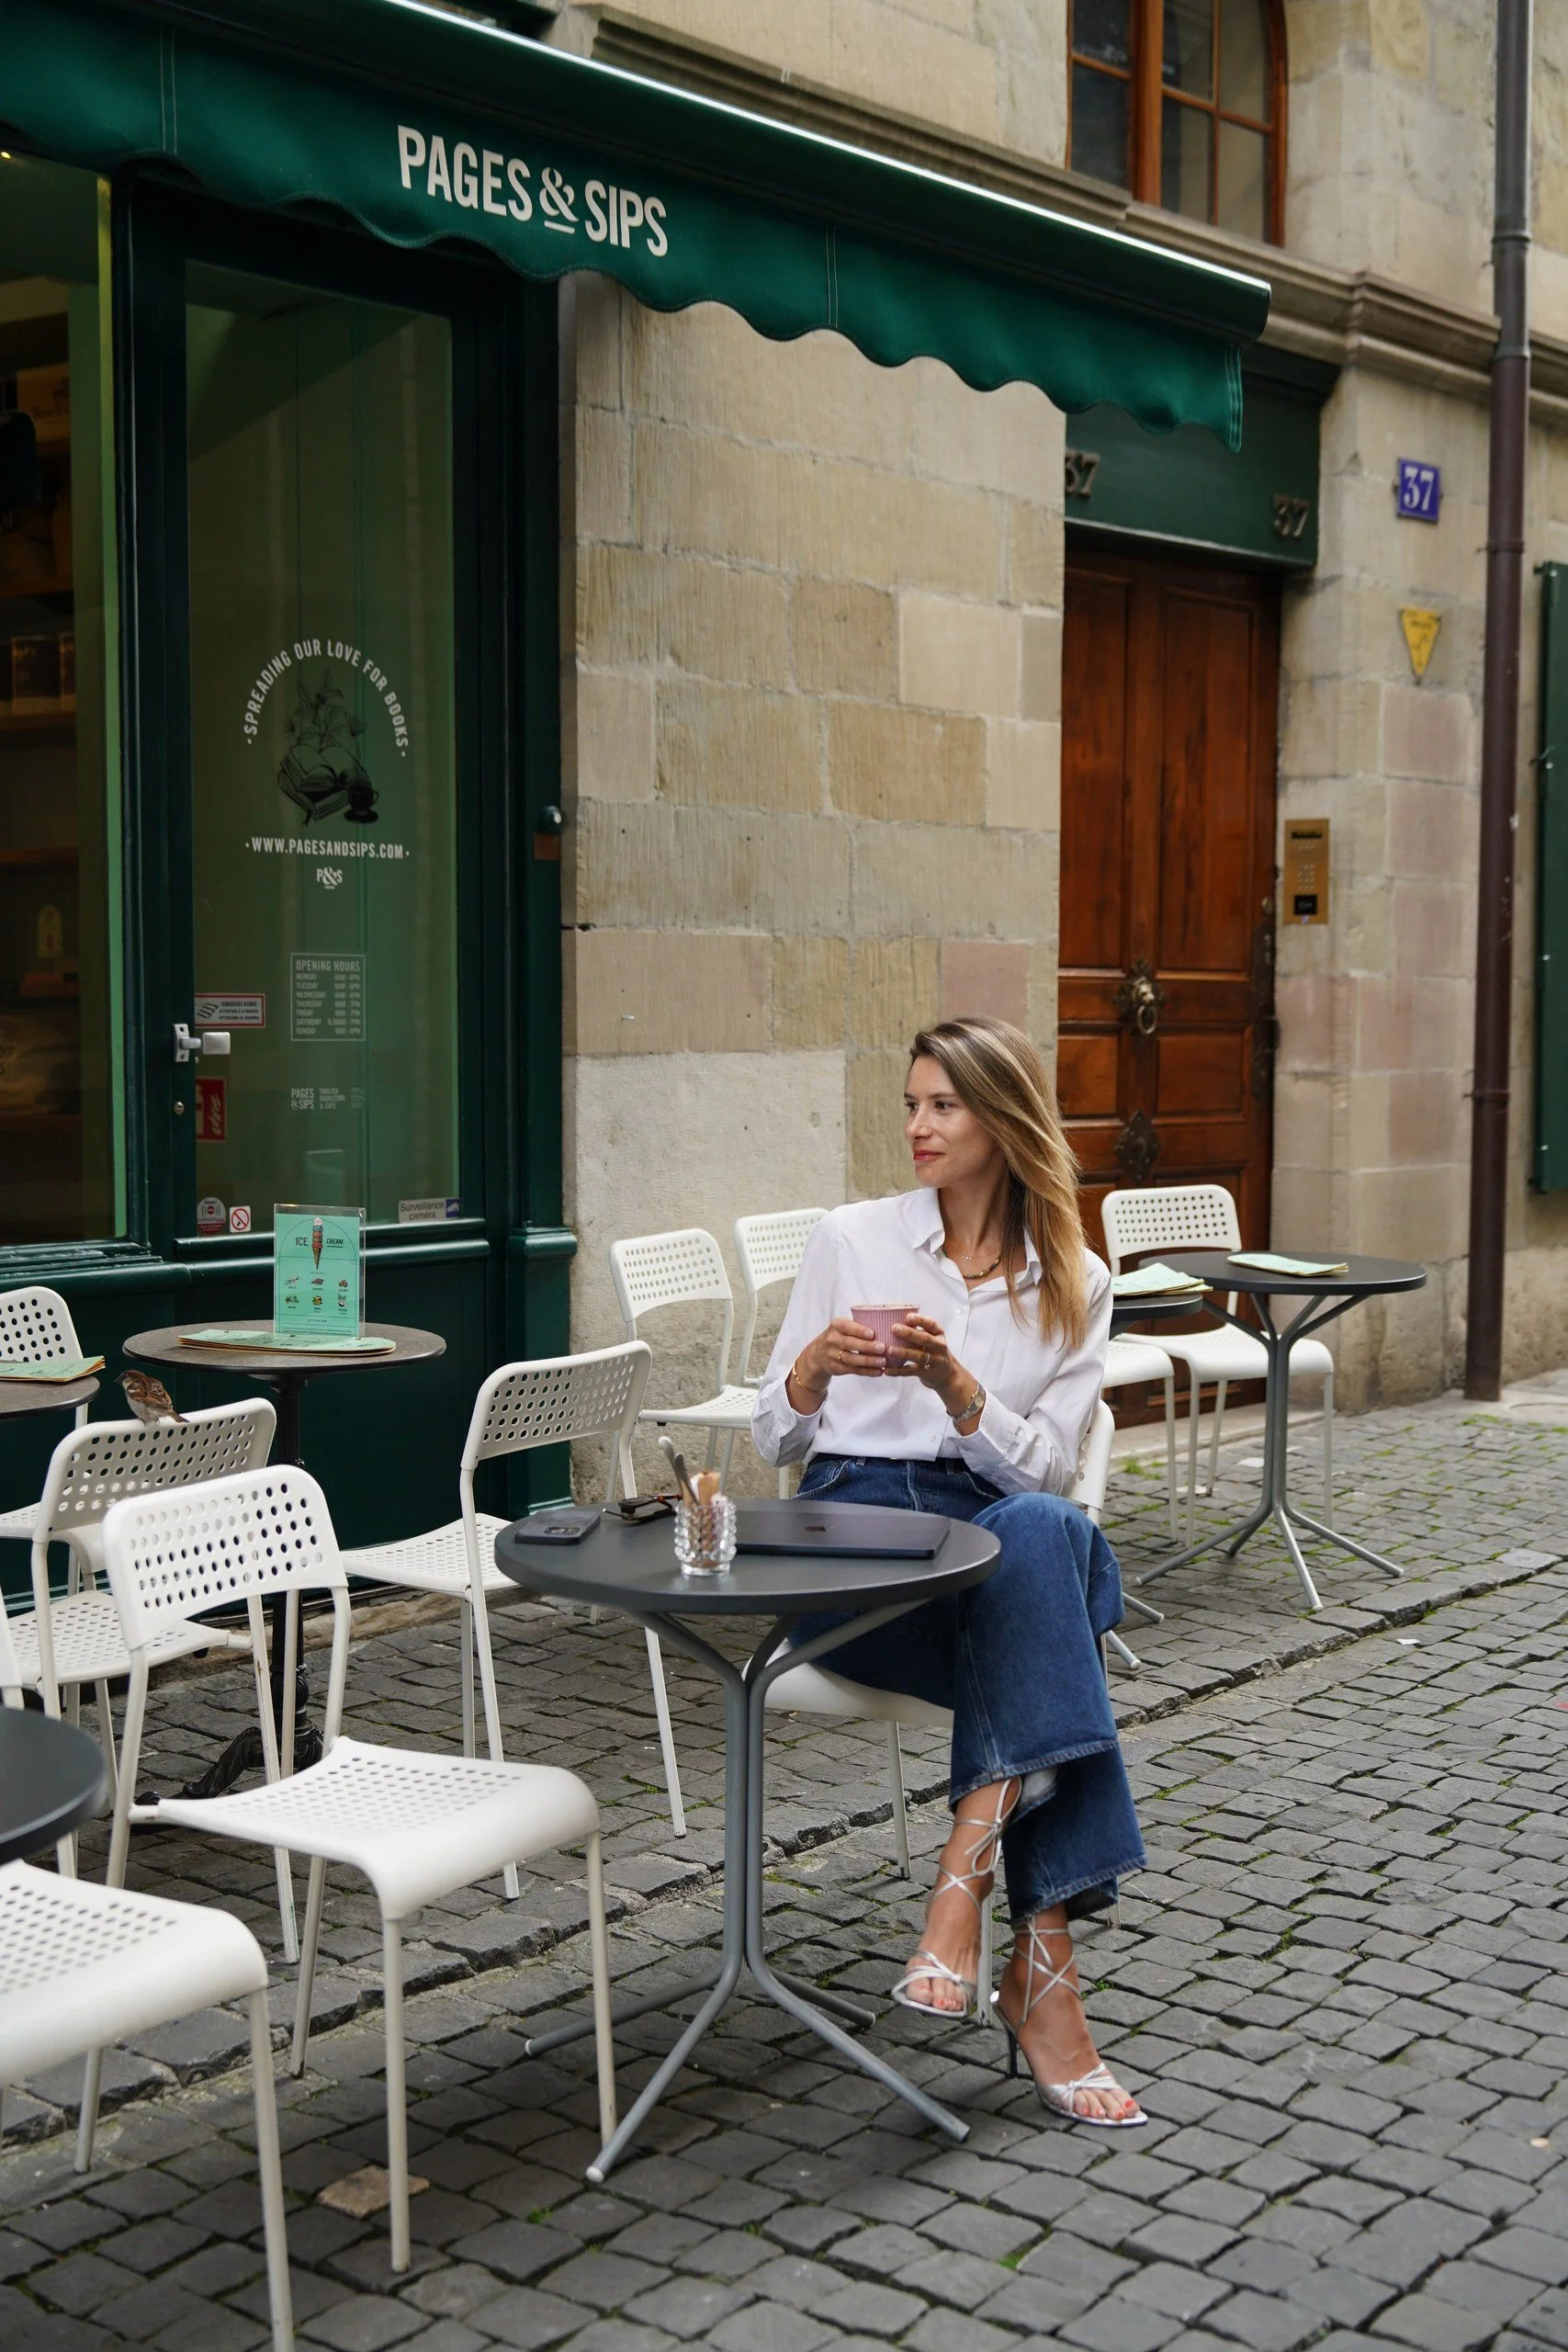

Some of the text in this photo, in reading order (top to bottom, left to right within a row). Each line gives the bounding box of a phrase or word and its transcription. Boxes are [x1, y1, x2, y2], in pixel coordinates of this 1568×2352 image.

[398, 124, 669, 257] PAGES & SIPS
[1404, 466, 1435, 511] 37
[1274, 495, 1311, 537] 37
[243, 639, 409, 748] SPREADING OUR LOVE FOR BOOKS
[251, 836, 403, 859] WWW.PAGESANDSIPS.COM
[296, 959, 360, 972] OPENING HOURS
[296, 1000, 322, 1008] THURSDAY
[291, 1088, 315, 1099] PAGES
[400, 1202, 445, 1213] Surveillance
[409, 1210, 436, 1220] caméra
[295, 1237, 309, 1247] ICE
